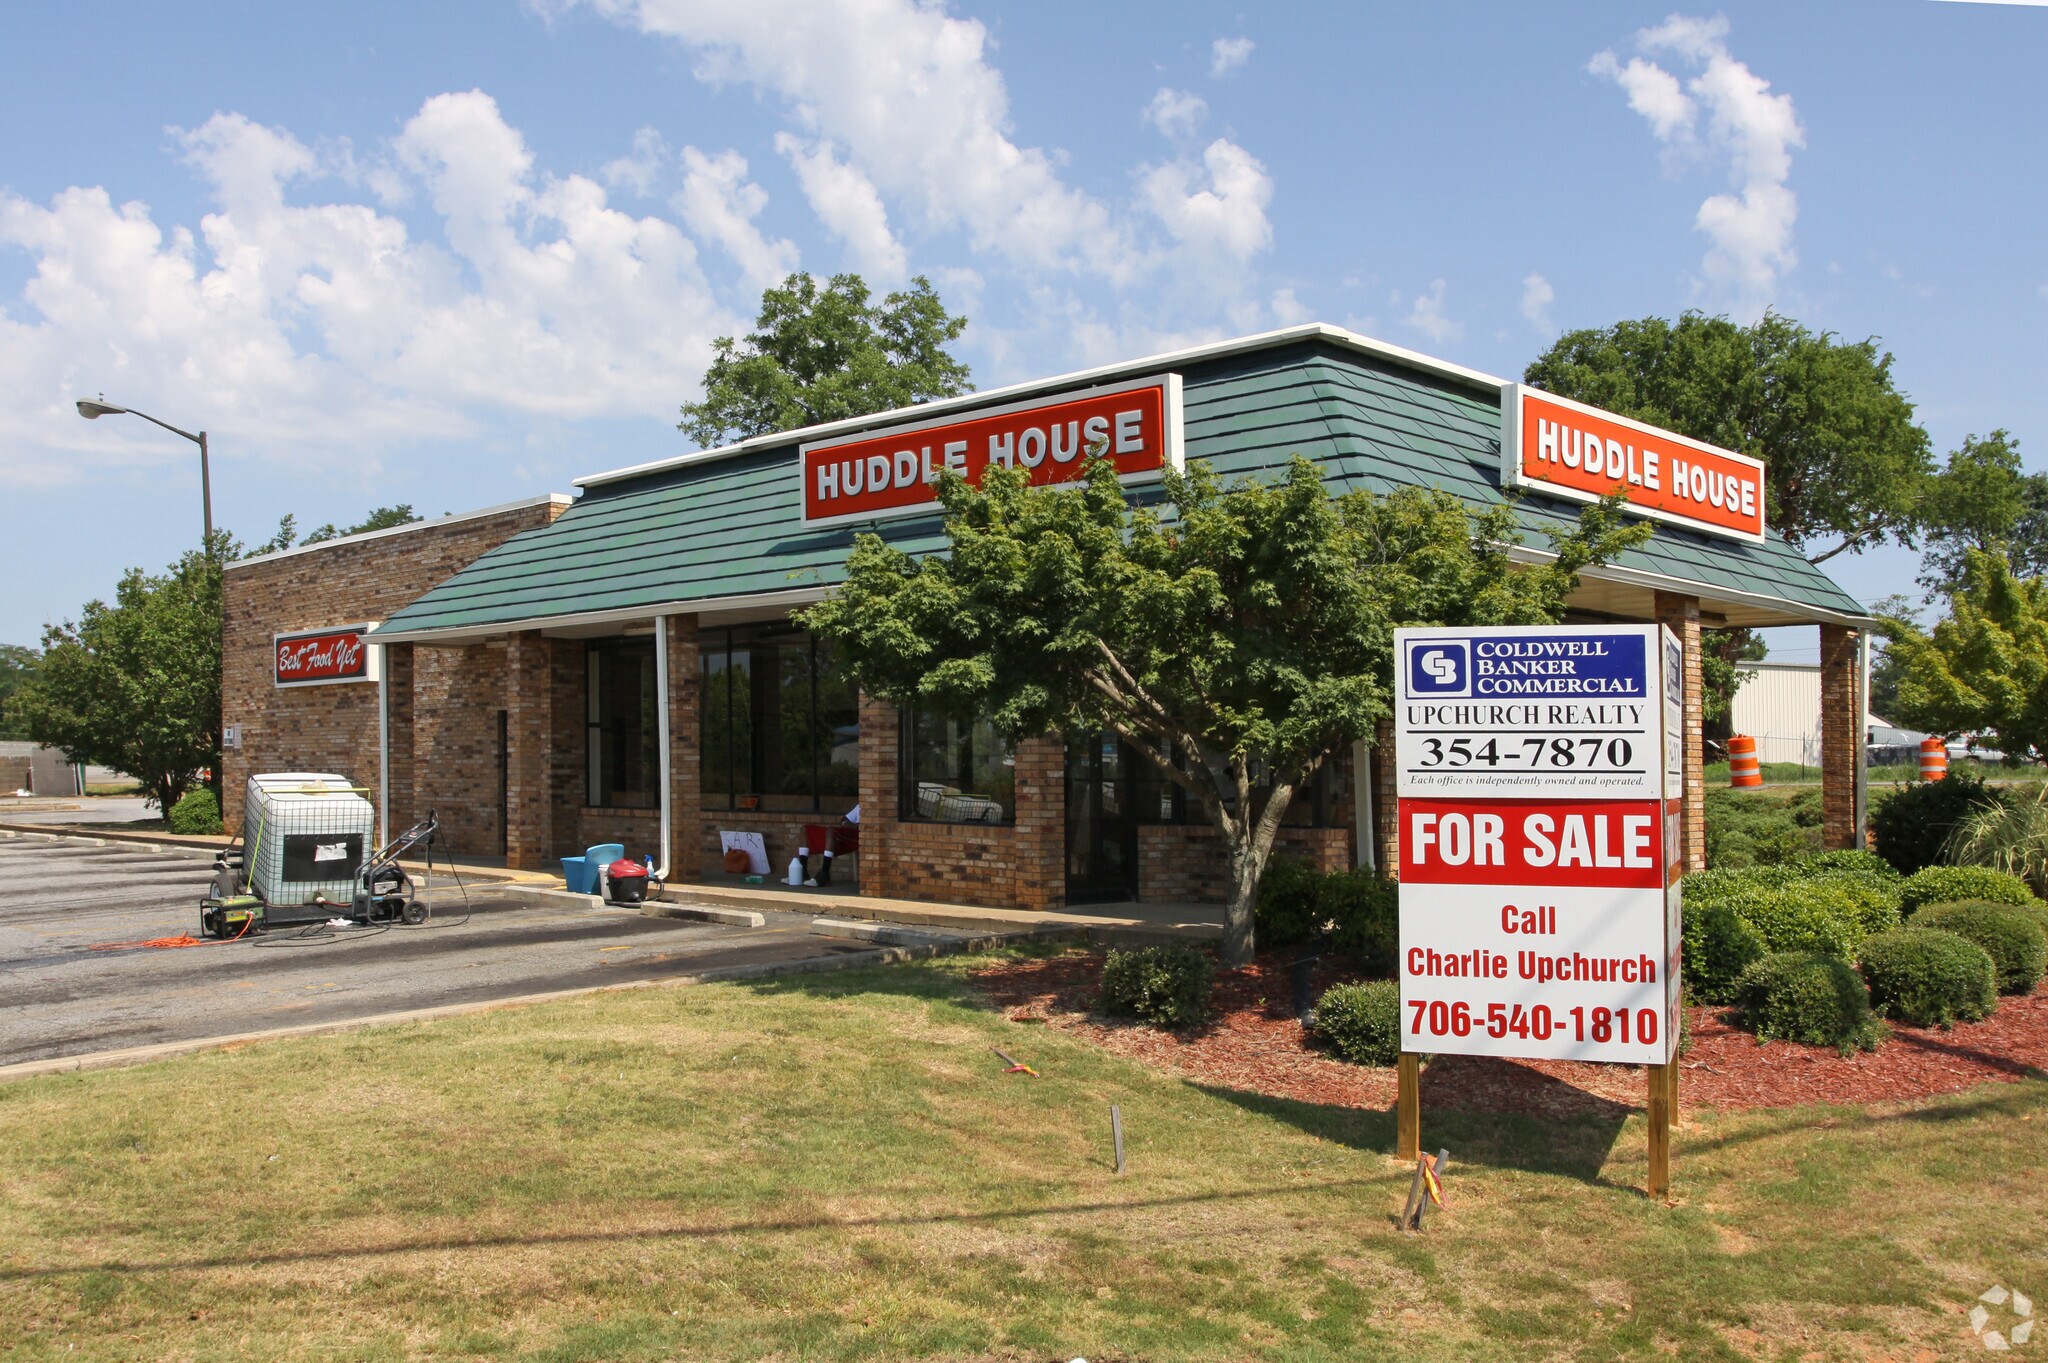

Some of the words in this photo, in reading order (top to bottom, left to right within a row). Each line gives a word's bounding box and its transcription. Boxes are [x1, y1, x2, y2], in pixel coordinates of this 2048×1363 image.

[817, 440, 968, 500] HUDDLE
[989, 409, 1144, 470] HOUSE
[1538, 418, 1660, 490] HUDDLE
[1672, 459, 1756, 517] HOUSE
[280, 645, 306, 671] Best
[306, 642, 333, 671] Food
[336, 639, 361, 672] Yet
[1476, 641, 1609, 658] COLDWELL
[1476, 659, 1577, 676] BANKER
[1477, 677, 1639, 694] COMMERCIAL
[1407, 705, 1539, 725] UPCHURCH
[1546, 704, 1645, 725] REALTY
[1420, 738, 1632, 767] 354-7870
[1410, 775, 1434, 785] Each
[1437, 775, 1464, 787] office
[1466, 775, 1473, 785] is
[1476, 775, 1541, 787] independently
[1545, 777, 1576, 785] owned
[1579, 776, 1597, 785] and
[1600, 776, 1645, 787] operated.
[1411, 812, 1505, 866] FOR
[1523, 813, 1653, 868] SALE
[1501, 904, 1556, 935] Call
[1407, 947, 1508, 978] Charlie
[1518, 951, 1656, 983] Upchurch
[1408, 1000, 1658, 1045] 706-540-1810
